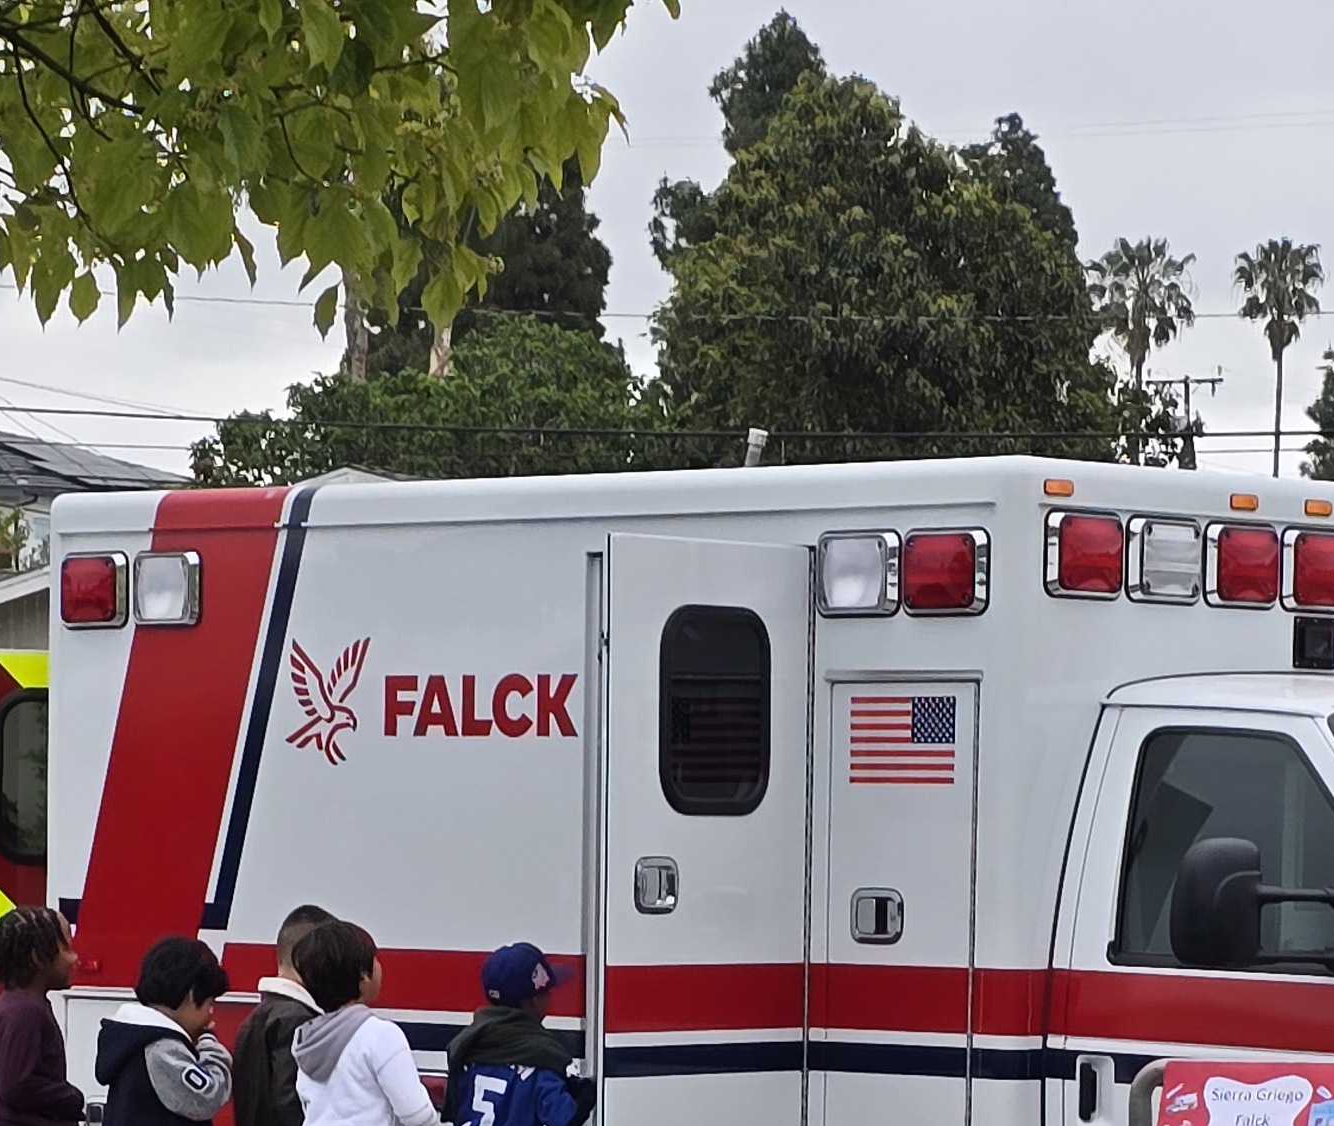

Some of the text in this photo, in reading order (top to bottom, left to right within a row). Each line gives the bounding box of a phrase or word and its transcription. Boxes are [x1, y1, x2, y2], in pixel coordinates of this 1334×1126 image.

[383, 672, 579, 738] FALCK
[1211, 1088, 1252, 1101] Sierra
[1235, 1114, 1270, 1126] Falck
